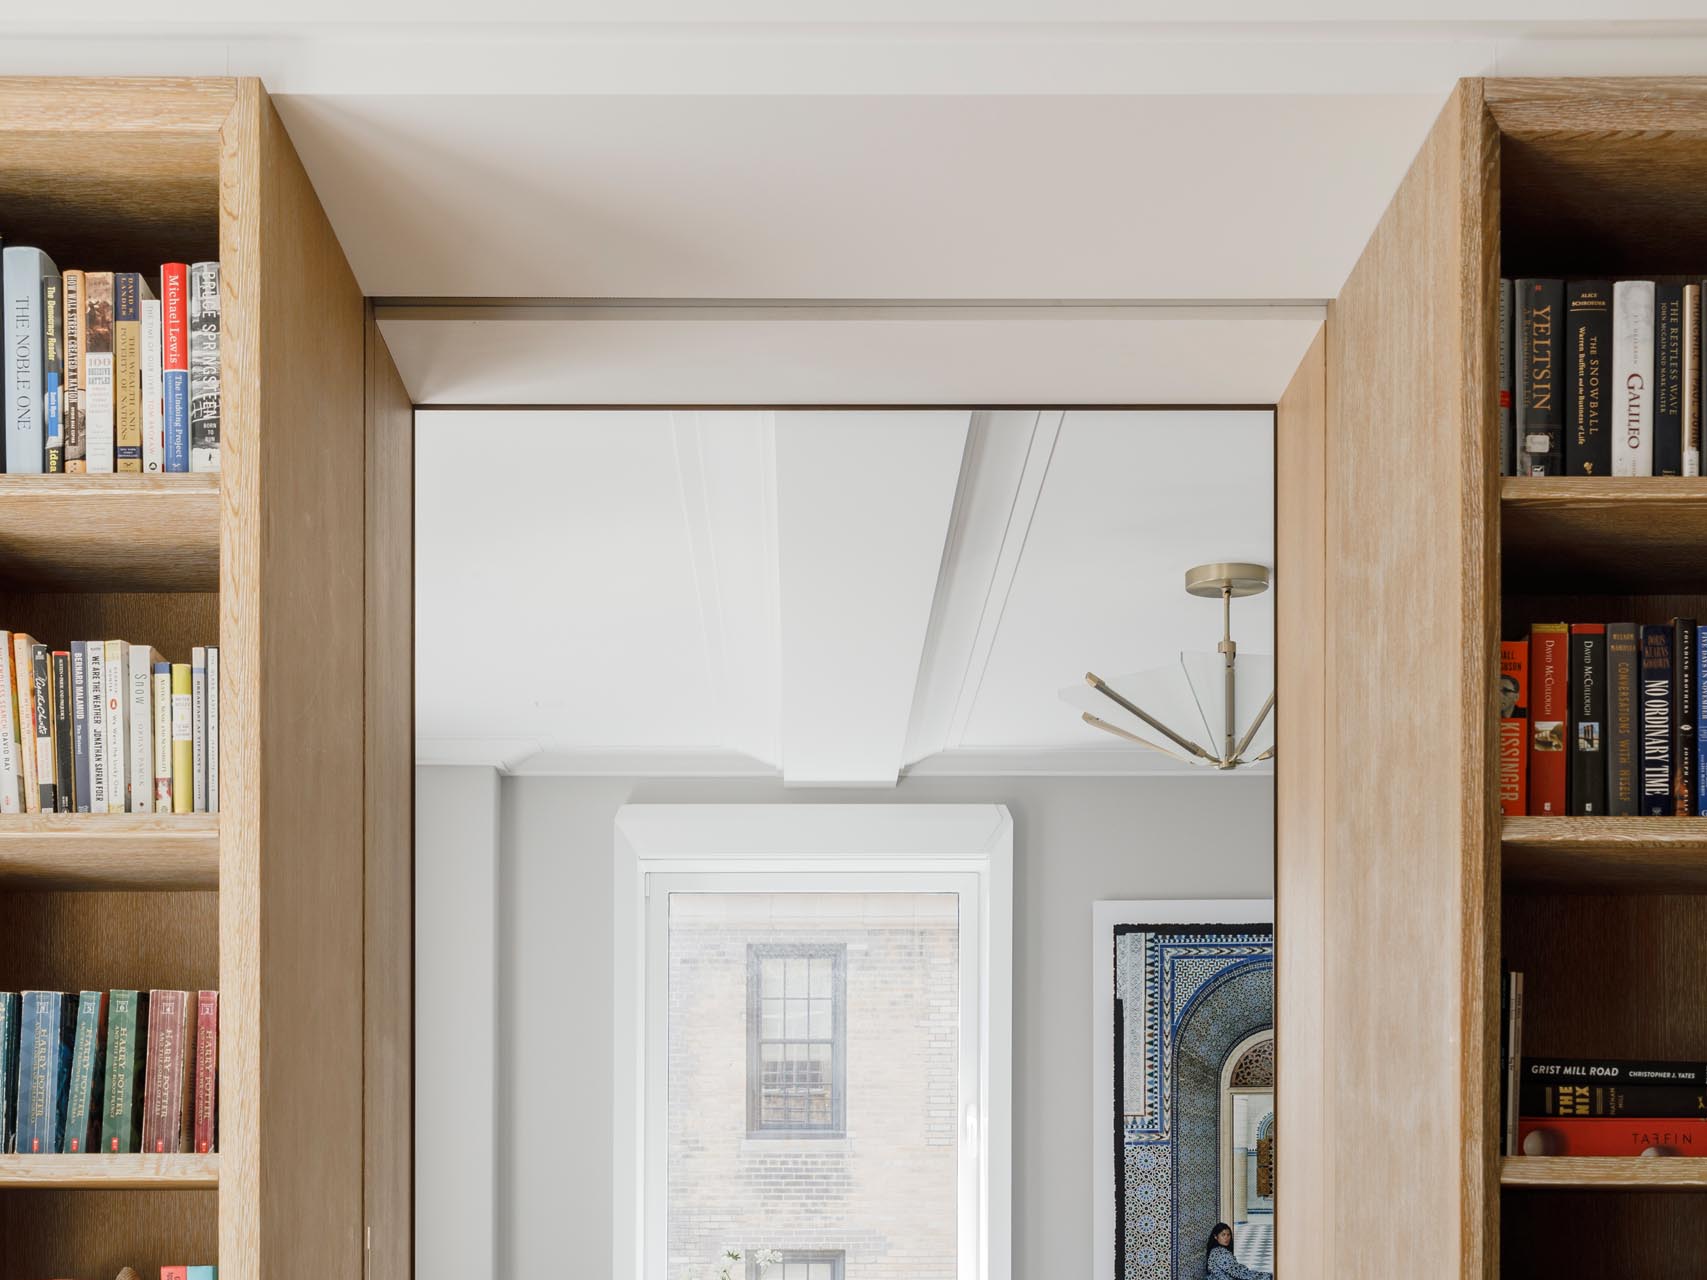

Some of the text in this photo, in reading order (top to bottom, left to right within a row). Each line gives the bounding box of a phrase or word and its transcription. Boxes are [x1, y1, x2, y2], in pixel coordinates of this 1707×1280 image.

[68, 275, 77, 291] HOW
[68, 293, 77, 310] WALL
[168, 275, 180, 325] Michael
[46, 287, 56, 360] The Democracy Reader
[68, 312, 78, 338] STREET
[1692, 294, 1700, 360] CHURCHILL
[68, 340, 78, 370] CREATED
[169, 329, 180, 363] Lewis
[202, 272, 216, 418] BRUCE SPRINGSTEEN
[1533, 306, 1551, 411] YELTSIN
[1669, 301, 1678, 416] THE RESTLESS WAVE
[15, 296, 31, 431] THE NOBLE ONE
[68, 379, 78, 402] NATION
[120, 376, 127, 391] OF
[1589, 337, 1599, 435] THE SNOWBALL
[174, 392, 183, 426] Undoing
[1627, 374, 1644, 449] GALILEO
[174, 429, 183, 458] Project
[49, 450, 57, 472] idea
[92, 656, 100, 666] WE
[1545, 640, 1554, 662] DAVID
[1584, 641, 1593, 663] DAVID
[74, 653, 83, 684] BERNARD
[92, 667, 100, 679] ARE
[75, 687, 84, 719] MALAMUD
[135, 674, 146, 705] Snow
[93, 695, 102, 724] WEATHER
[93, 729, 102, 761] JONATHAN
[1618, 662, 1632, 801] CONVERSATIONS WITH MYSELF
[1645, 680, 1669, 795] NO ORDINARY TIME
[94, 764, 103, 785] SAFRAN
[1501, 723, 1519, 801] KISSINGER
[95, 787, 103, 801] FOER
[36, 1029, 48, 1117] HARRY POTTER
[77, 1029, 92, 1117] HARRY POTTER
[115, 1028, 128, 1116] HARRY POTTER
[161, 1029, 173, 1118] HARRY POTTER
[1532, 1065, 1560, 1075] GRIST
[1563, 1066, 1586, 1075] MILL
[1590, 1067, 1619, 1076] ROAD
[1560, 1086, 1589, 1115] THE NIX
